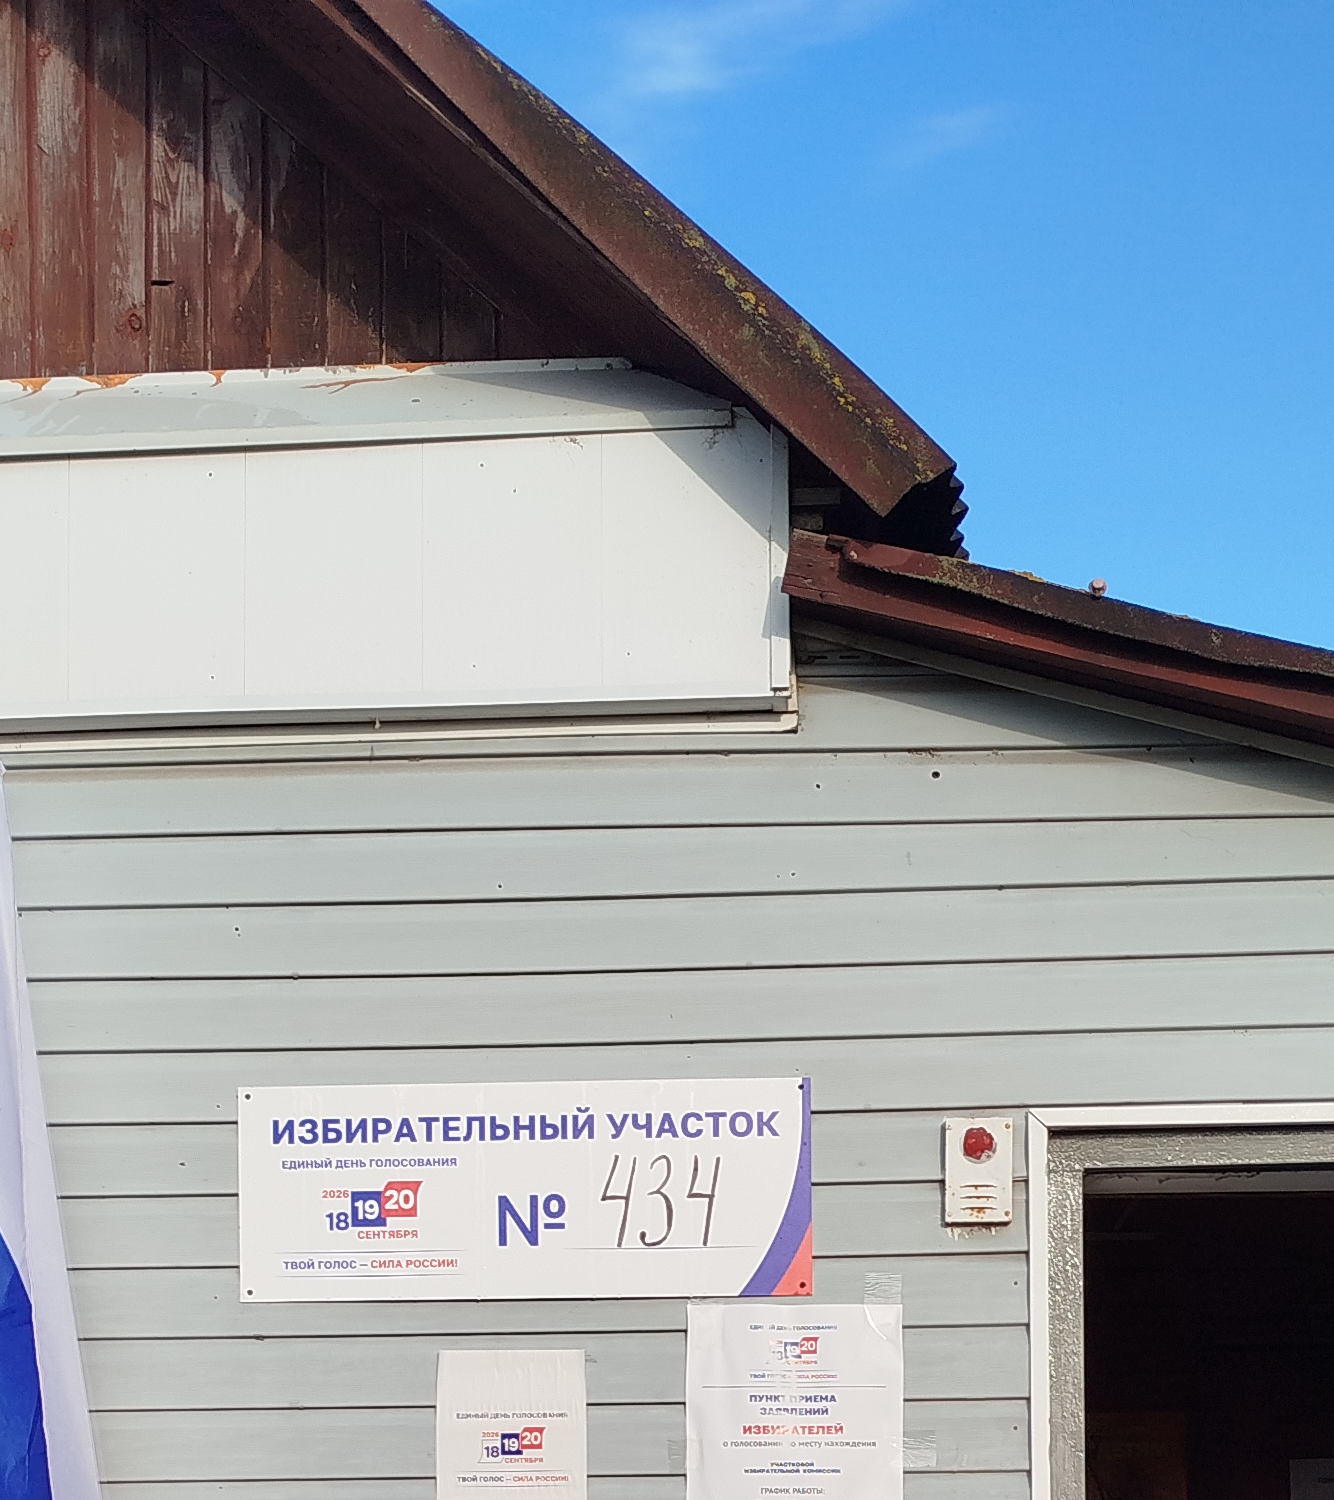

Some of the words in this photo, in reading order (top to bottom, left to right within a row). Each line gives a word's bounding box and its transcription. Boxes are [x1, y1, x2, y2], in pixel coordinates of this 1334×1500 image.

[271, 1107, 596, 1145] ИЗБИРАТЕЛЬНЫЙ
[608, 1110, 781, 1139] УЧАСТОК
[281, 1158, 333, 1170] ЕДИНЫЙ
[335, 1159, 367, 1170] ДЕНЬ
[369, 1158, 458, 1168] ГОЛОСОВАНИЯ
[321, 1190, 350, 1199] 2026
[497, 1192, 567, 1247] №
[599, 1154, 722, 1248] 434
[325, 1212, 350, 1231] 18
[354, 1199, 380, 1220] 19
[384, 1189, 415, 1210] 20
[357, 1229, 419, 1240] СЕНТЯБРЯ
[283, 1259, 315, 1270] ТВОЙ
[318, 1260, 358, 1270] ГОЛОС
[370, 1259, 403, 1269] СИЛА
[405, 1258, 458, 1269] РОССИИ!
[800, 1340, 816, 1351] 20
[483, 1445, 500, 1458] 18
[503, 1437, 519, 1452] 19
[521, 1431, 541, 1445] 20
[479, 1475, 504, 1483] ГОЛОС
[760, 1487, 791, 1495] ГРАФИК
[792, 1487, 826, 1495] РАБОТЫ:
